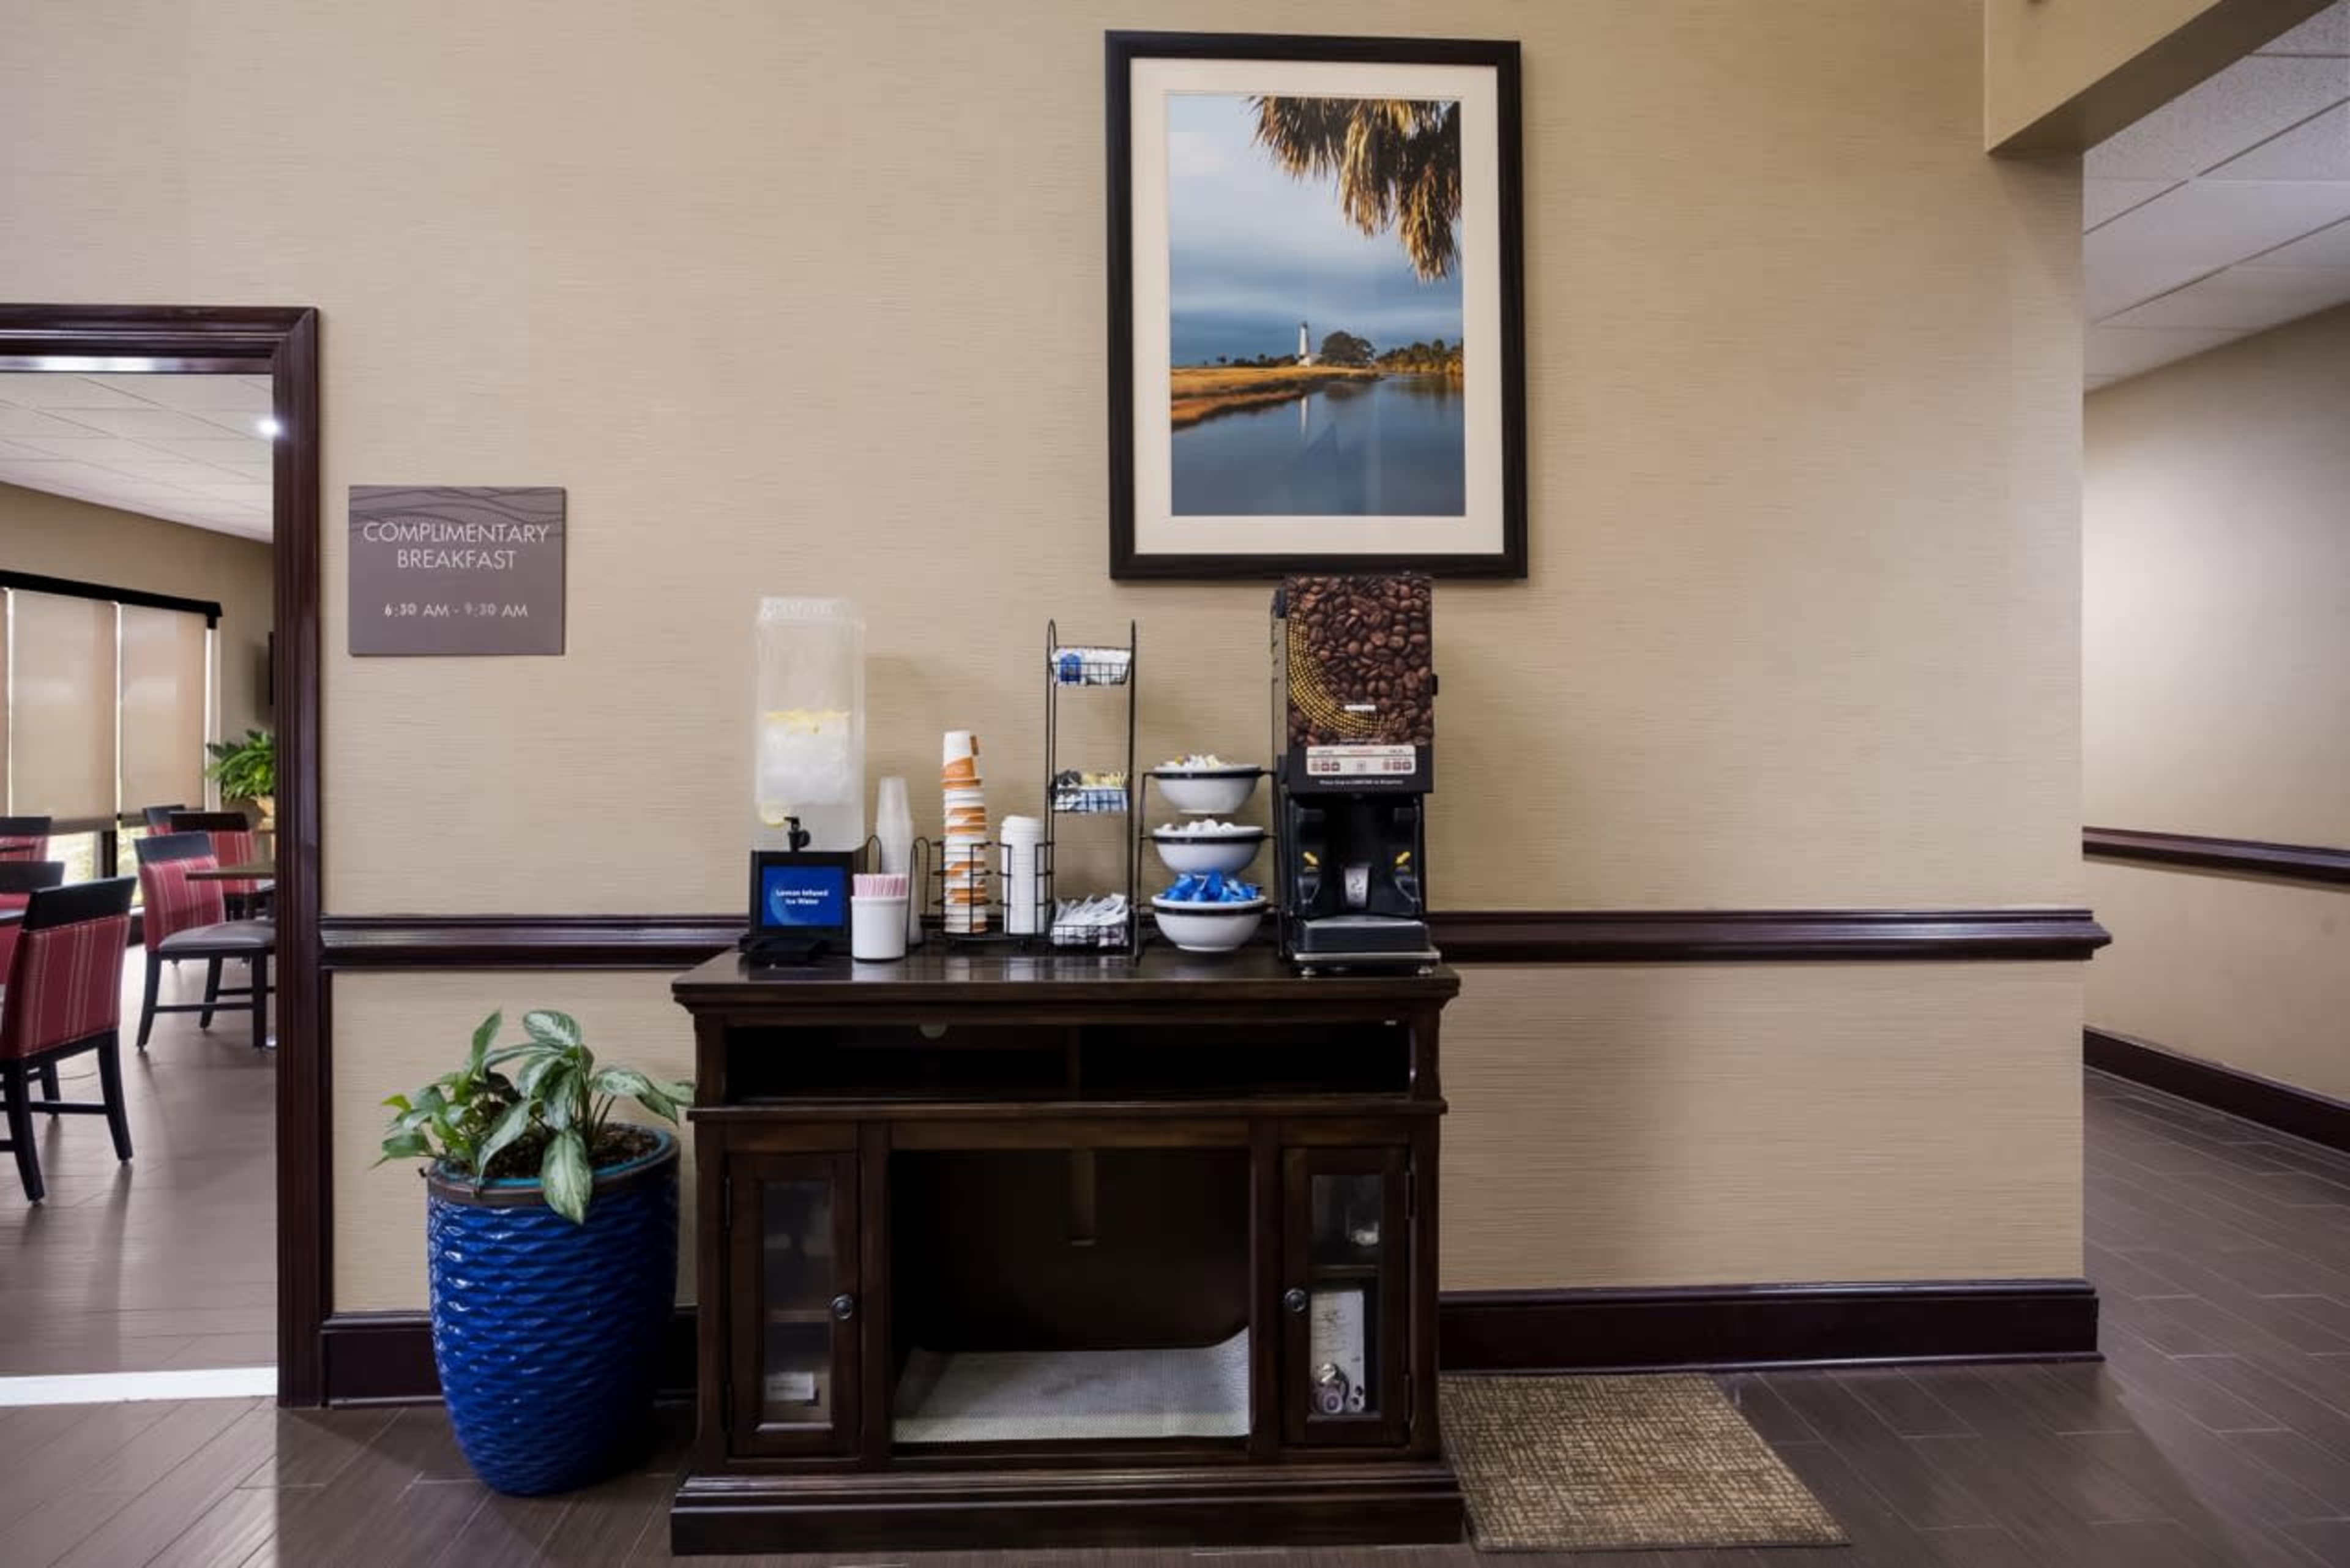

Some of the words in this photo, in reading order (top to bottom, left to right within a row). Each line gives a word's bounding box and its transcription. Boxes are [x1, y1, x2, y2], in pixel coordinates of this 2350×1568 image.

[363, 522, 550, 543] COMPLIMENTARY
[397, 549, 516, 570] BREAKFAST
[384, 602, 417, 617] 6:30
[423, 603, 450, 617] AM
[501, 603, 529, 617] AM
